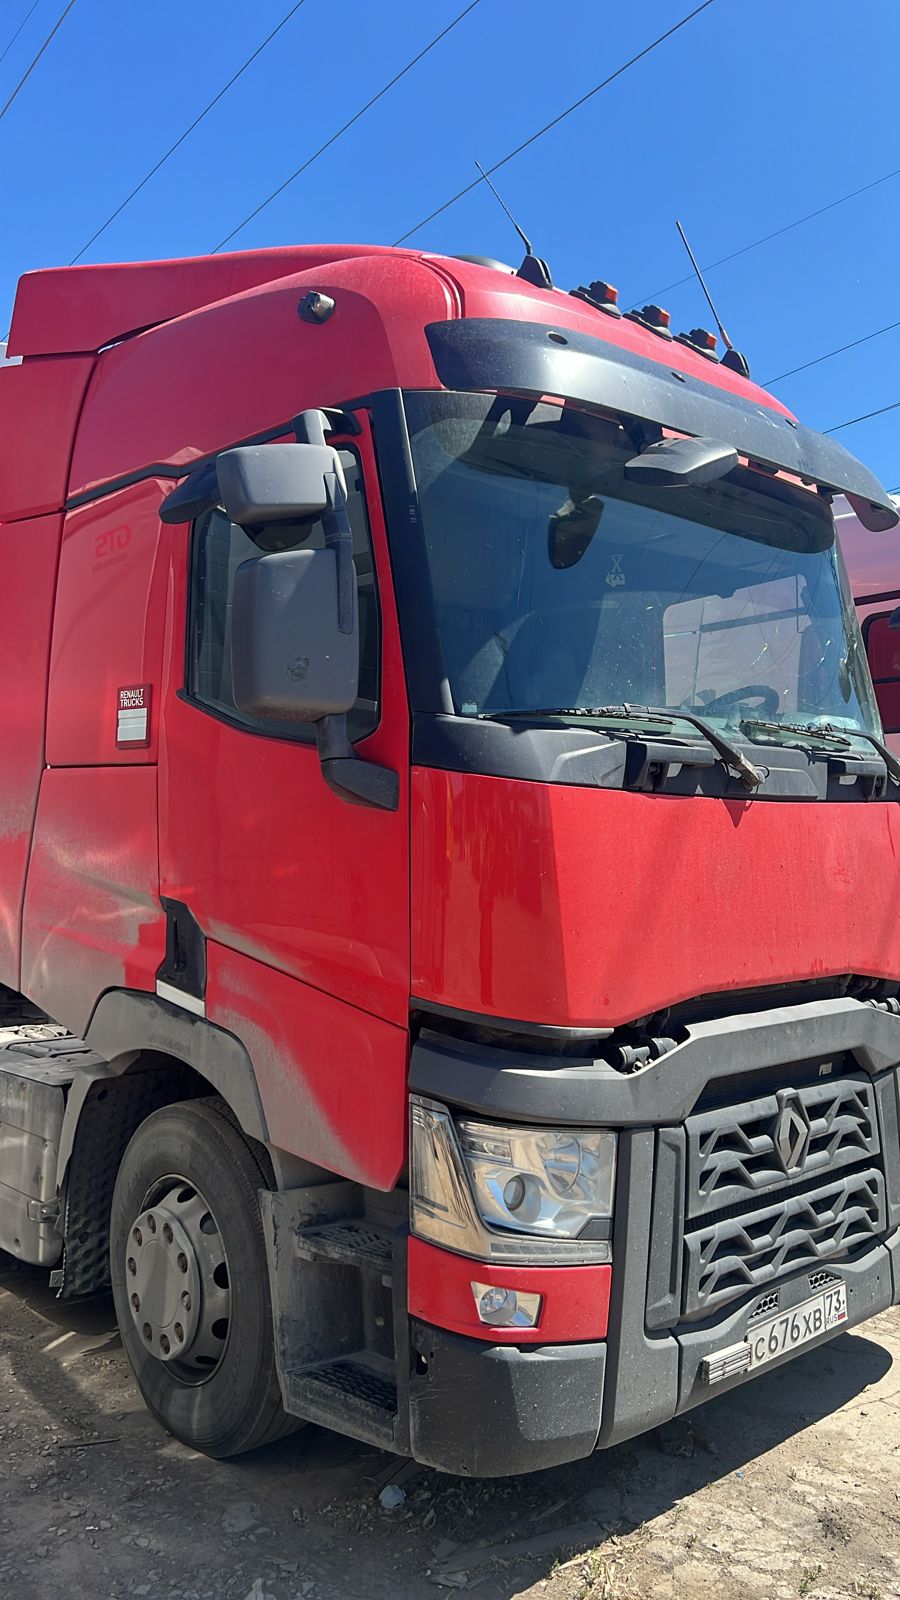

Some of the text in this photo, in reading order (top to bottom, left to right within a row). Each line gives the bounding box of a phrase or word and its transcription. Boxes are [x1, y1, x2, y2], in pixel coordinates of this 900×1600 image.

[120, 689, 144, 699] RENAULT
[120, 698, 144, 707] TRUCKS
[826, 1290, 842, 1317] 73
[826, 1314, 838, 1324] RUS
